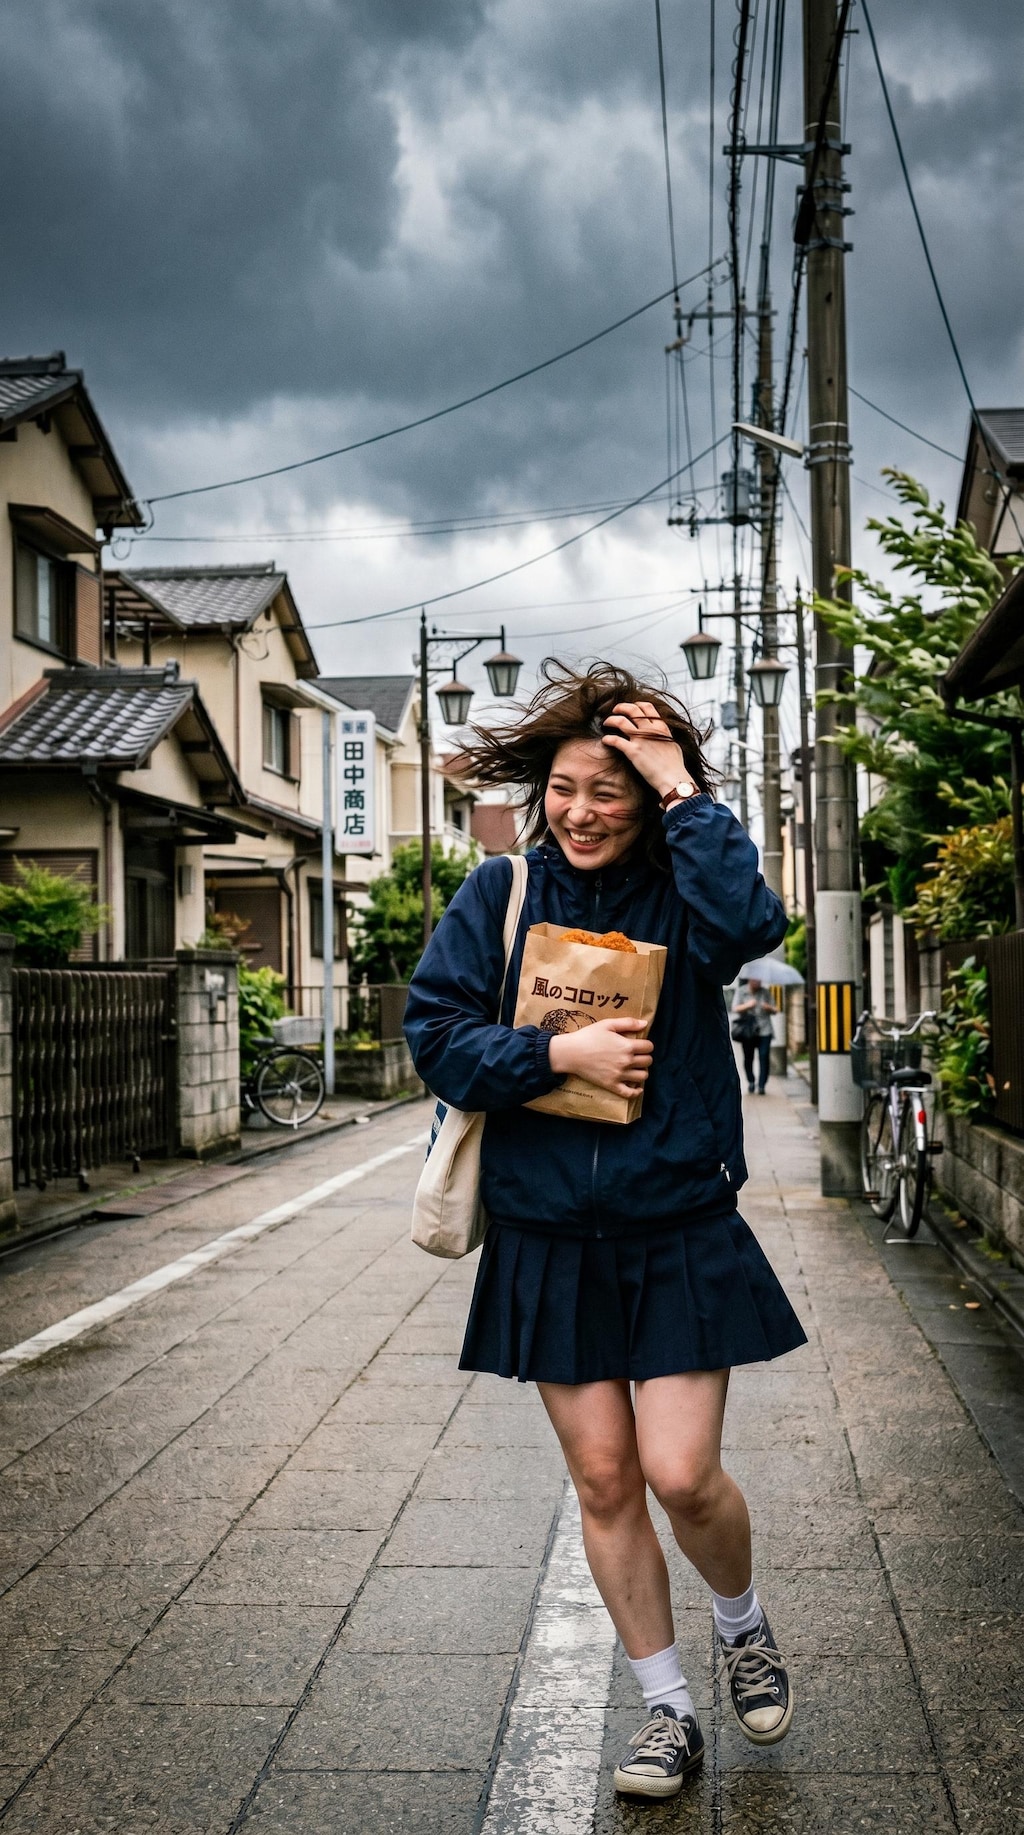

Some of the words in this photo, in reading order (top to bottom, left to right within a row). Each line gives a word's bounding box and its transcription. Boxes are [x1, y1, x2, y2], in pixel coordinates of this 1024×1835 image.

[344, 741, 365, 835] 田中商店
[531, 977, 629, 1009] 風のコロッケ
